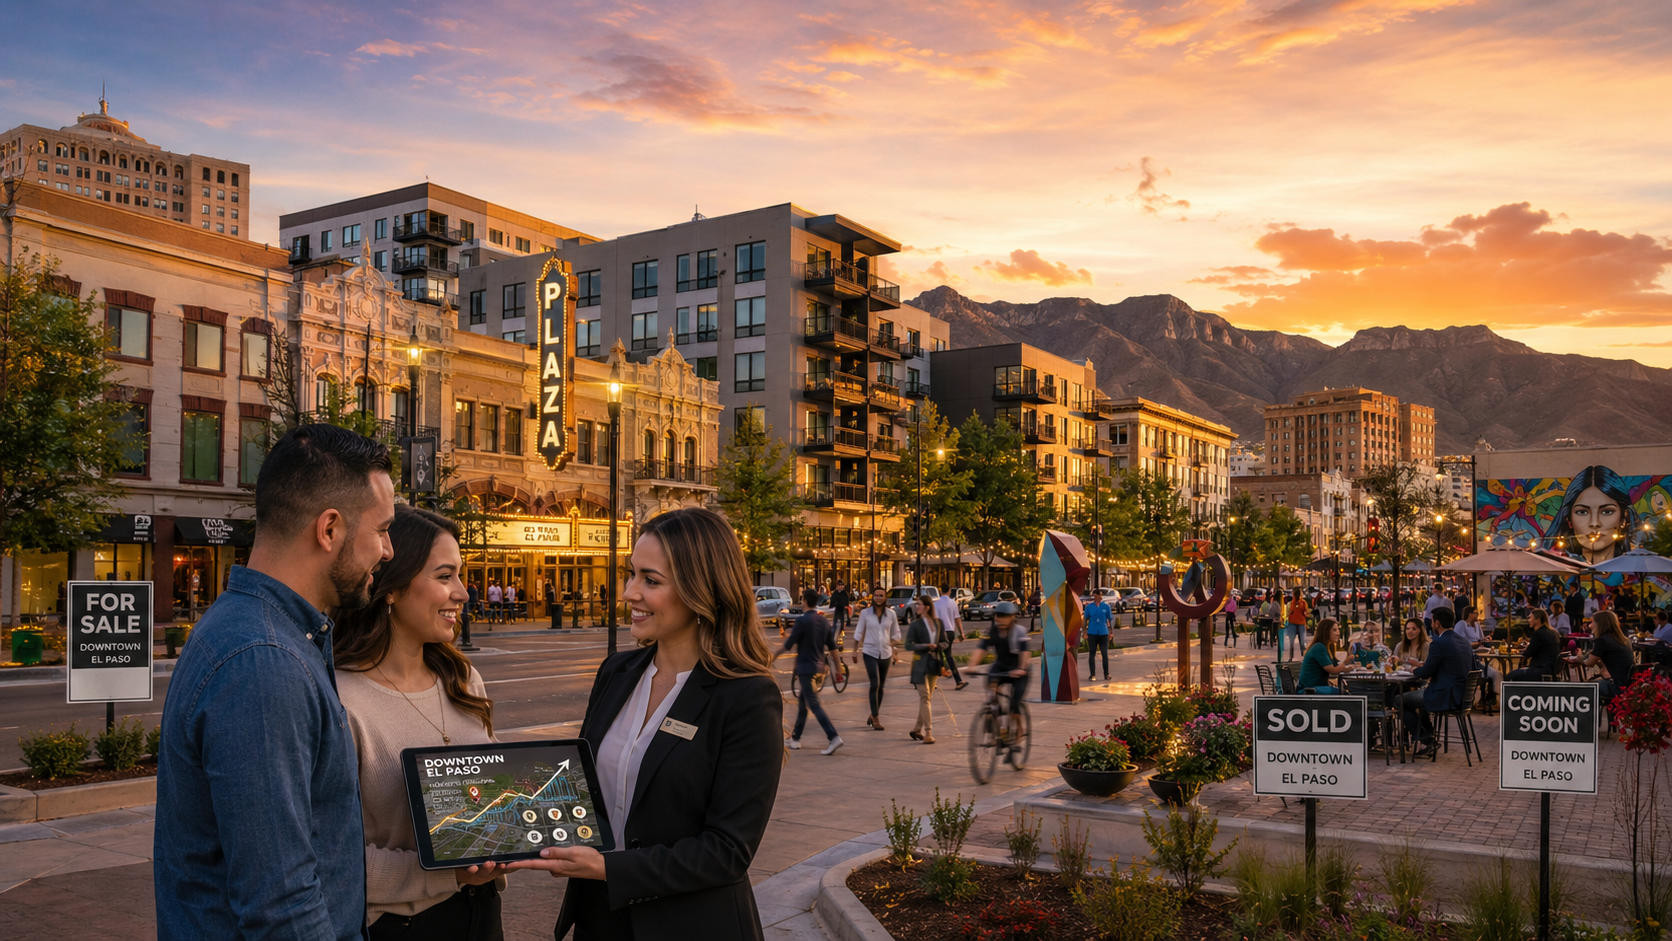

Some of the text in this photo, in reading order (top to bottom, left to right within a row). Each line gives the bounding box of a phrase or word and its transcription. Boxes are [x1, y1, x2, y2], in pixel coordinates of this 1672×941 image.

[542, 282, 561, 448] PLAZA
[86, 593, 135, 611] FOR
[80, 615, 141, 634] SALE
[80, 642, 141, 652] DOWNTOWN
[91, 655, 131, 664] EL PASO
[1508, 695, 1591, 713] COMING
[1267, 708, 1352, 733] SOLD
[1519, 716, 1578, 734] SOON
[424, 755, 505, 768] DOWNTOWN
[1267, 752, 1353, 765] DOWNTOWN
[1511, 751, 1586, 763] DOWNTOWN
[426, 765, 481, 778] EL PASO
[1523, 769, 1573, 781] EL PASO
[1282, 773, 1338, 785] EL PASO
